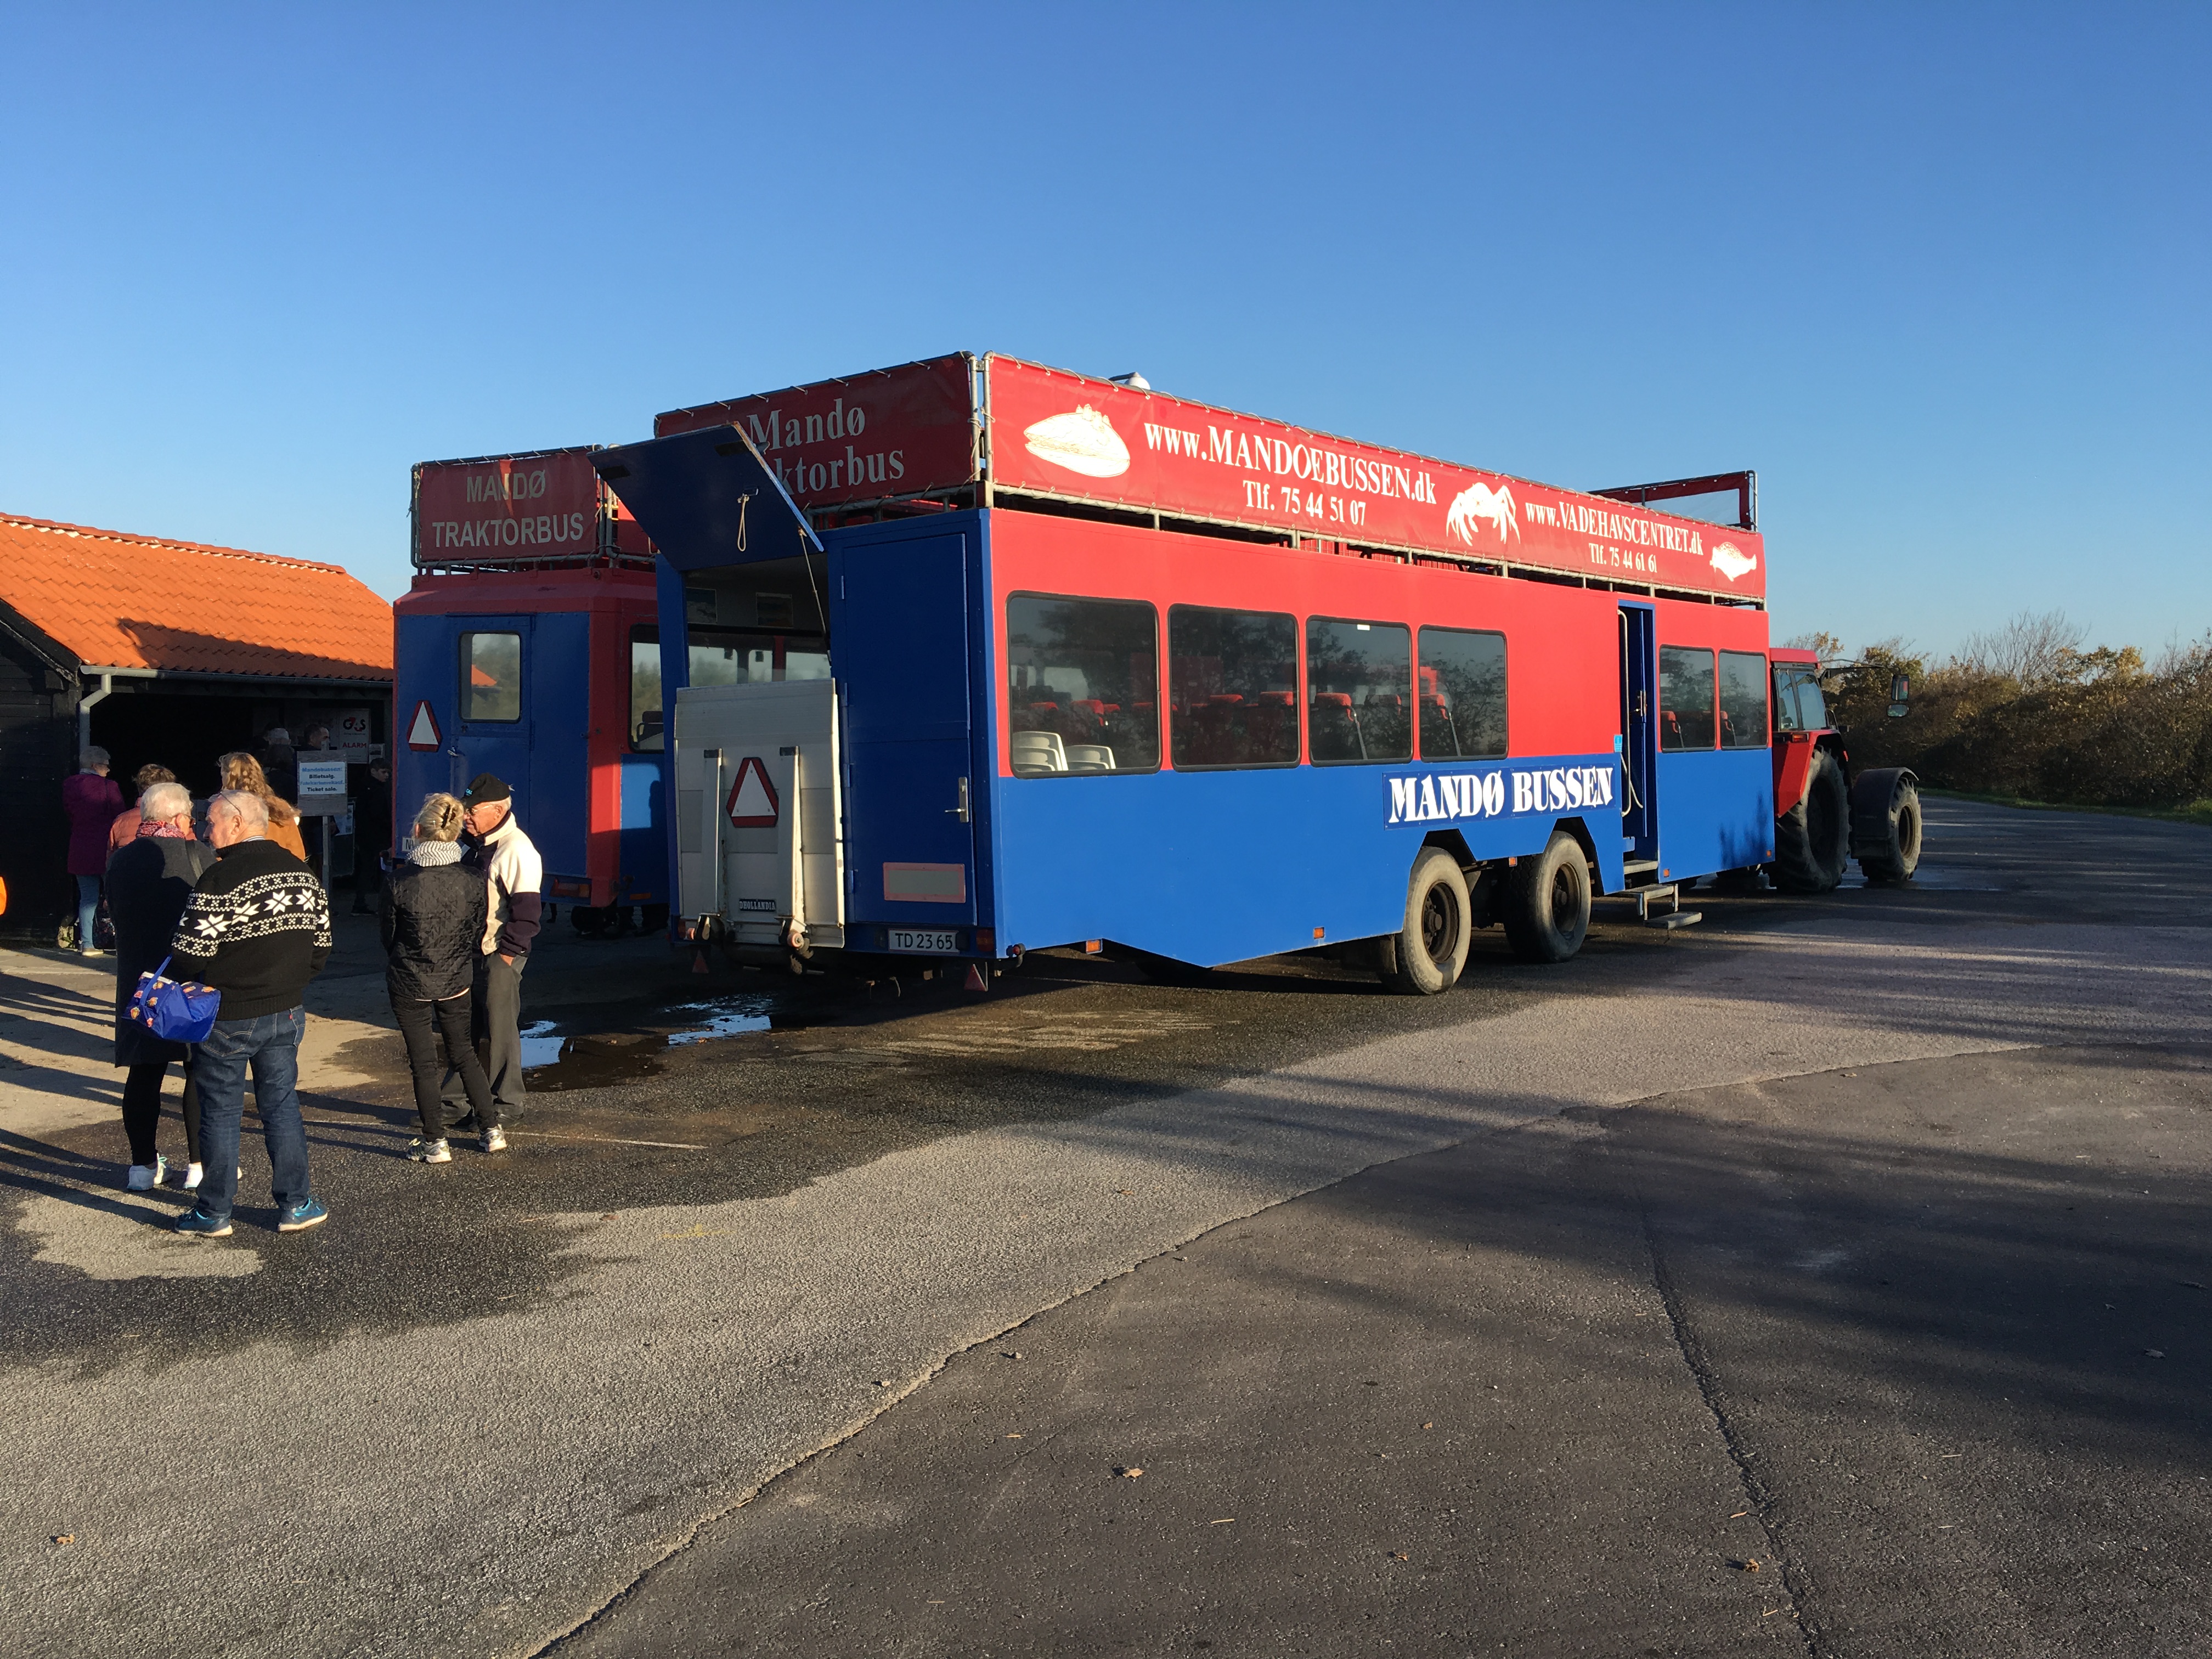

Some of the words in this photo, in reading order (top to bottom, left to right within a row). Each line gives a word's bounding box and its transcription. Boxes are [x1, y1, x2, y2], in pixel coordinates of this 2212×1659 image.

[746, 398, 866, 450] Mandø
[466, 469, 546, 503] MANDØ
[1243, 480, 1274, 510] Tlf.
[1281, 487, 1300, 514] 75
[1306, 492, 1324, 518] 44
[1330, 496, 1346, 523] 51
[1350, 500, 1366, 526] 07
[432, 512, 584, 548] TRAKTORBUS
[1589, 543, 1606, 565] Tlf.
[1609, 547, 1620, 566] 75
[1622, 550, 1633, 569] 44
[1635, 552, 1645, 571] 61
[1648, 554, 1658, 573] 61
[343, 717, 366, 731] G4S
[1388, 770, 1505, 823] MANDØ
[1511, 766, 1613, 813] BUSSEN
[739, 901, 776, 910] DHOLLANDIA
[895, 933, 913, 947] TD
[917, 934, 933, 949] 23
[936, 934, 952, 950] 65
